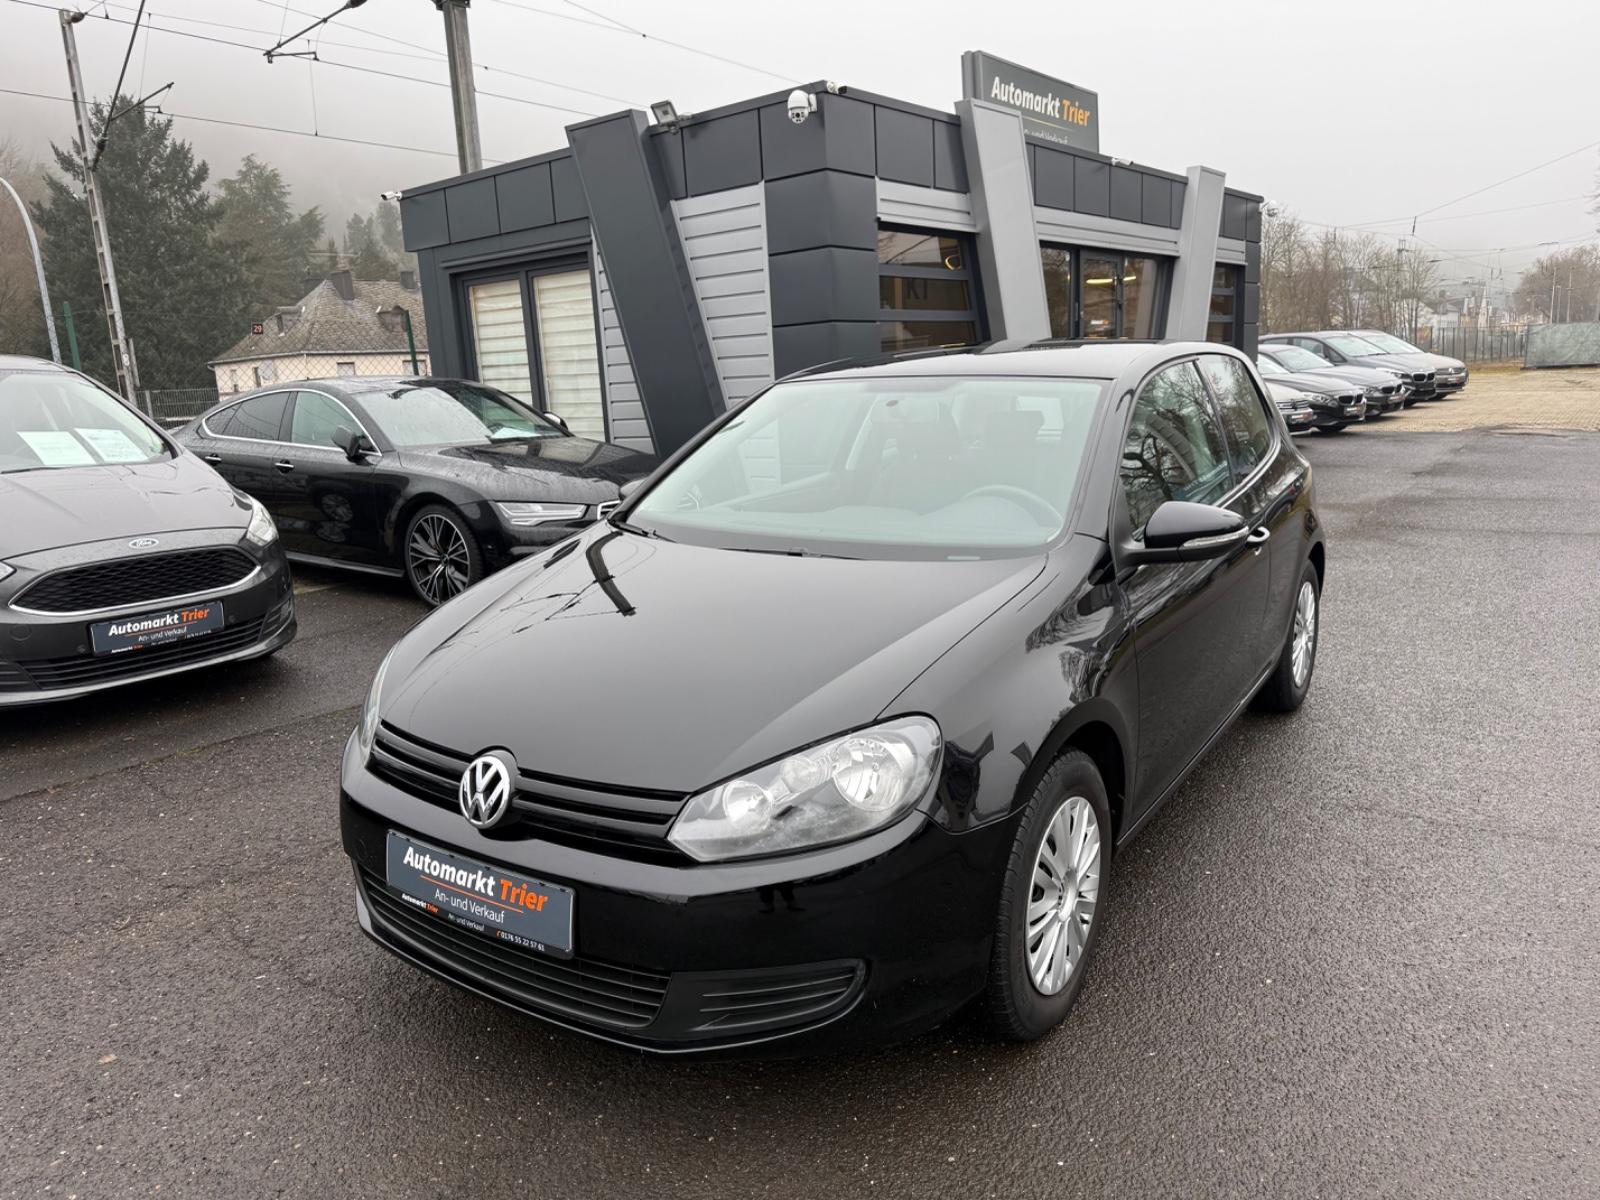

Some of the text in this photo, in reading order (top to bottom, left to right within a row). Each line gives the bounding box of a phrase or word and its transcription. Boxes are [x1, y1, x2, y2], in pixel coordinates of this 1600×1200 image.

[991, 76, 1090, 126] Automarkt Trier
[108, 613, 179, 637] Automarkt
[181, 608, 210, 622] Trier
[403, 846, 549, 912] Automarkt Trier
[435, 887, 505, 924] An- und Verkauf
